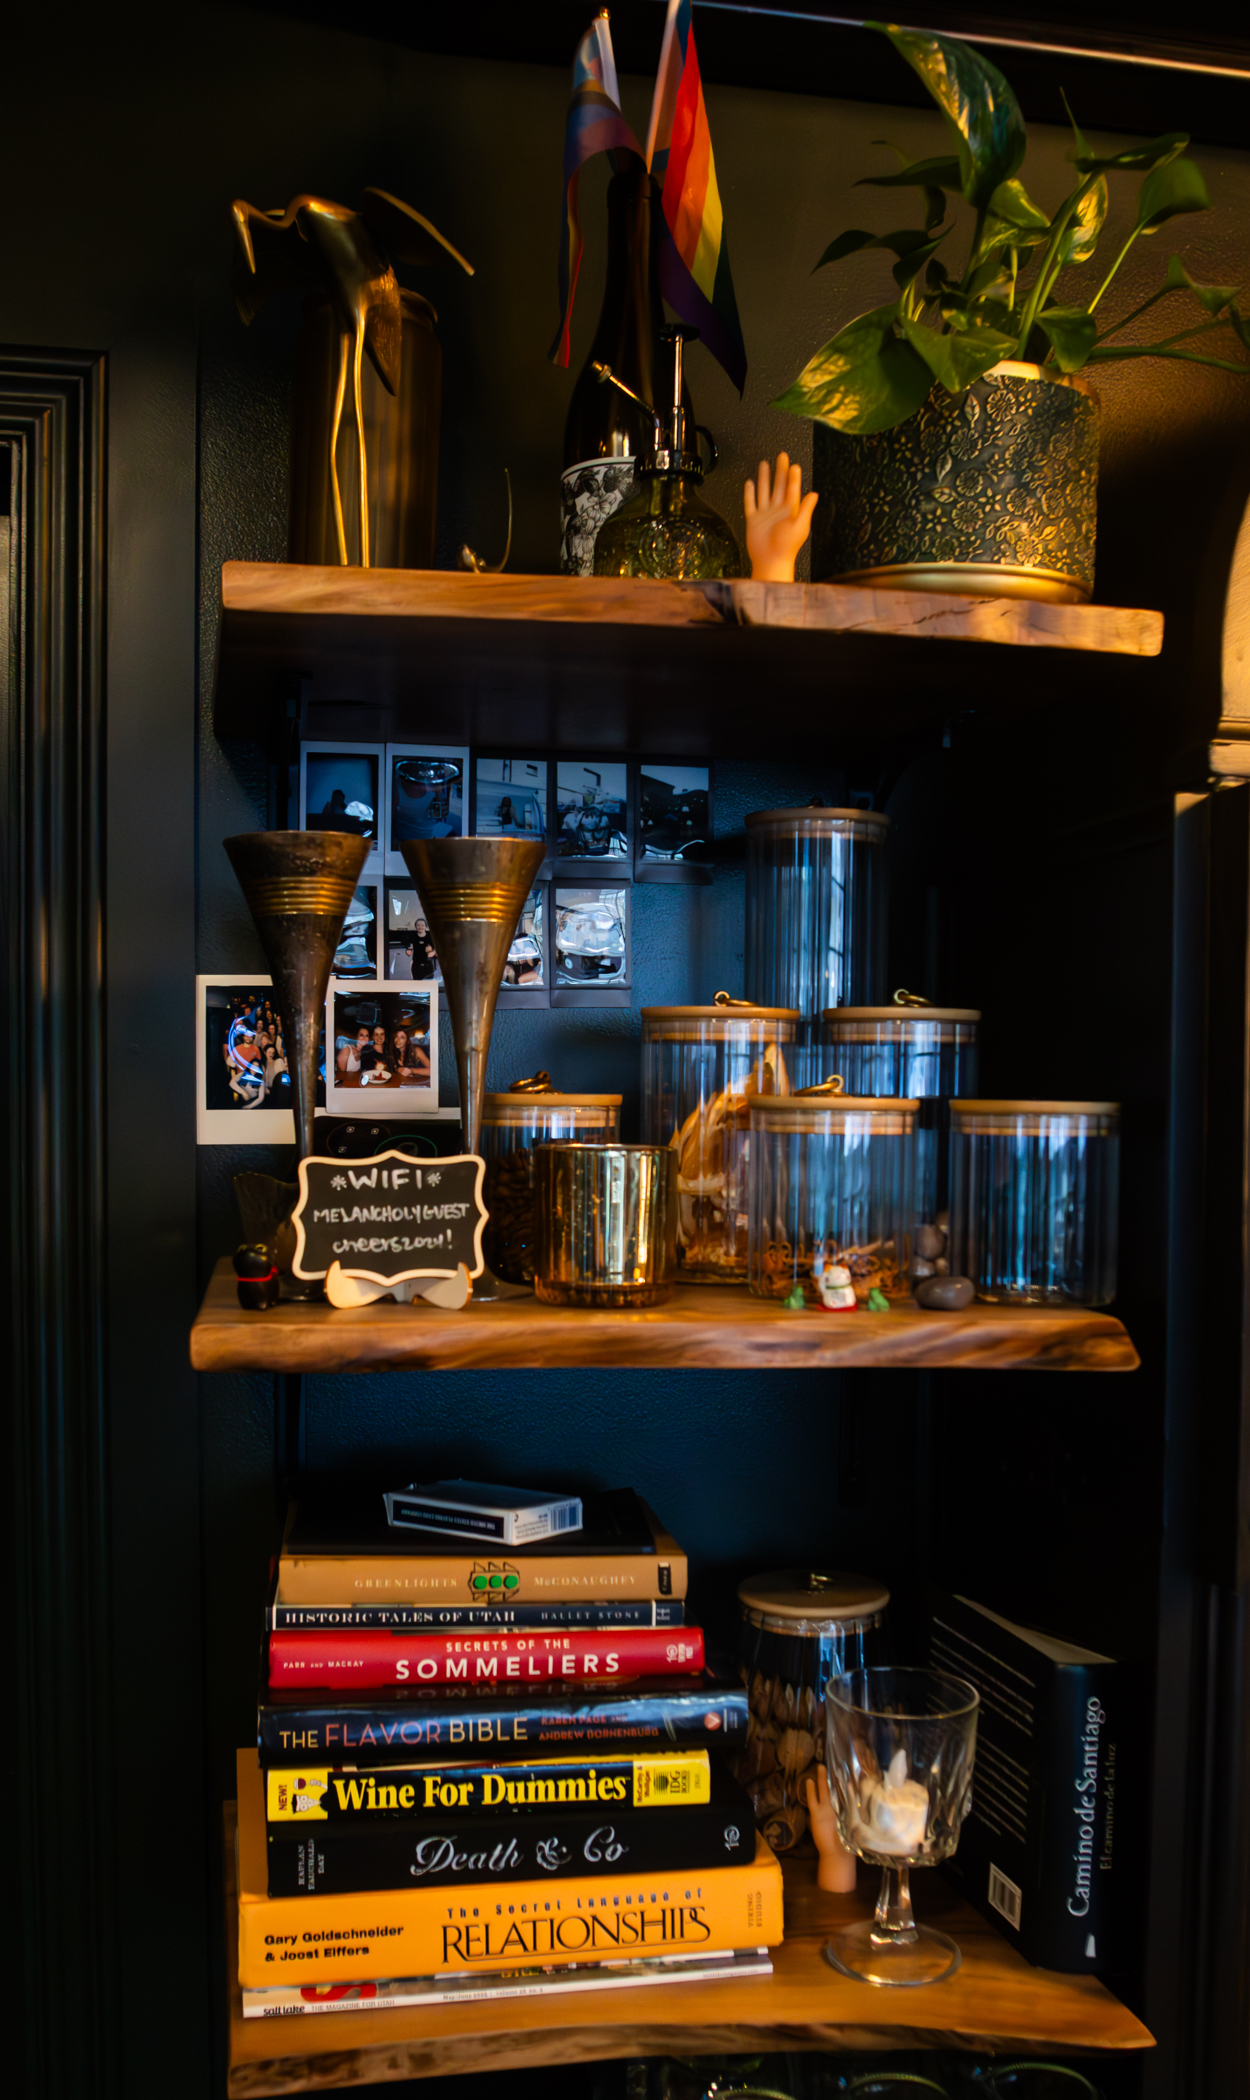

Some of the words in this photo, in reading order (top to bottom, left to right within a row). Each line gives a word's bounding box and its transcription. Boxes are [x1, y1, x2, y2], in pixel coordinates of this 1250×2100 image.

[313, 1203, 470, 1223] MELANCHOLYGUEST
[354, 1577, 458, 1588] GREENLIGHTS
[285, 1612, 373, 1624] HISTORIC
[378, 1611, 434, 1623] TALES
[439, 1611, 463, 1623] OF
[469, 1611, 515, 1622] UTAH
[598, 1610, 640, 1619] STONE
[446, 1640, 508, 1653] SECRETS
[517, 1639, 535, 1651] OF
[544, 1638, 571, 1649] THE
[283, 1661, 306, 1669] PARR
[327, 1660, 365, 1668] MACKAY
[395, 1652, 620, 1680] SOMMELIERS
[279, 1730, 319, 1749] THE
[325, 1721, 441, 1747] FLAVOR
[449, 1717, 529, 1743] BIBLE
[539, 1730, 584, 1741] ANDREW
[1074, 1696, 1107, 1793] Santiago
[278, 1784, 288, 1811] NEW!
[332, 1776, 415, 1811] Wine
[422, 1775, 474, 1807] For
[482, 1769, 627, 1806] Dummies
[1073, 1795, 1097, 1823] de
[410, 1835, 524, 1876] Death
[536, 1836, 572, 1871] &
[584, 1825, 630, 1862] Co
[1066, 1824, 1095, 1917] Camino
[447, 1908, 479, 1920] The
[576, 1890, 669, 1909] Language
[685, 1887, 702, 1900] of
[264, 1934, 298, 1946] Gary
[302, 1926, 404, 1943] Goldschneider
[442, 1906, 711, 1964] RELATIONSHIPS
[280, 1949, 319, 1961] Joost
[311, 2004, 325, 2012] THE
[326, 2001, 361, 2011] MAGAZINE
[362, 2000, 376, 2009] FOR
[377, 1999, 395, 2007] UTAH
